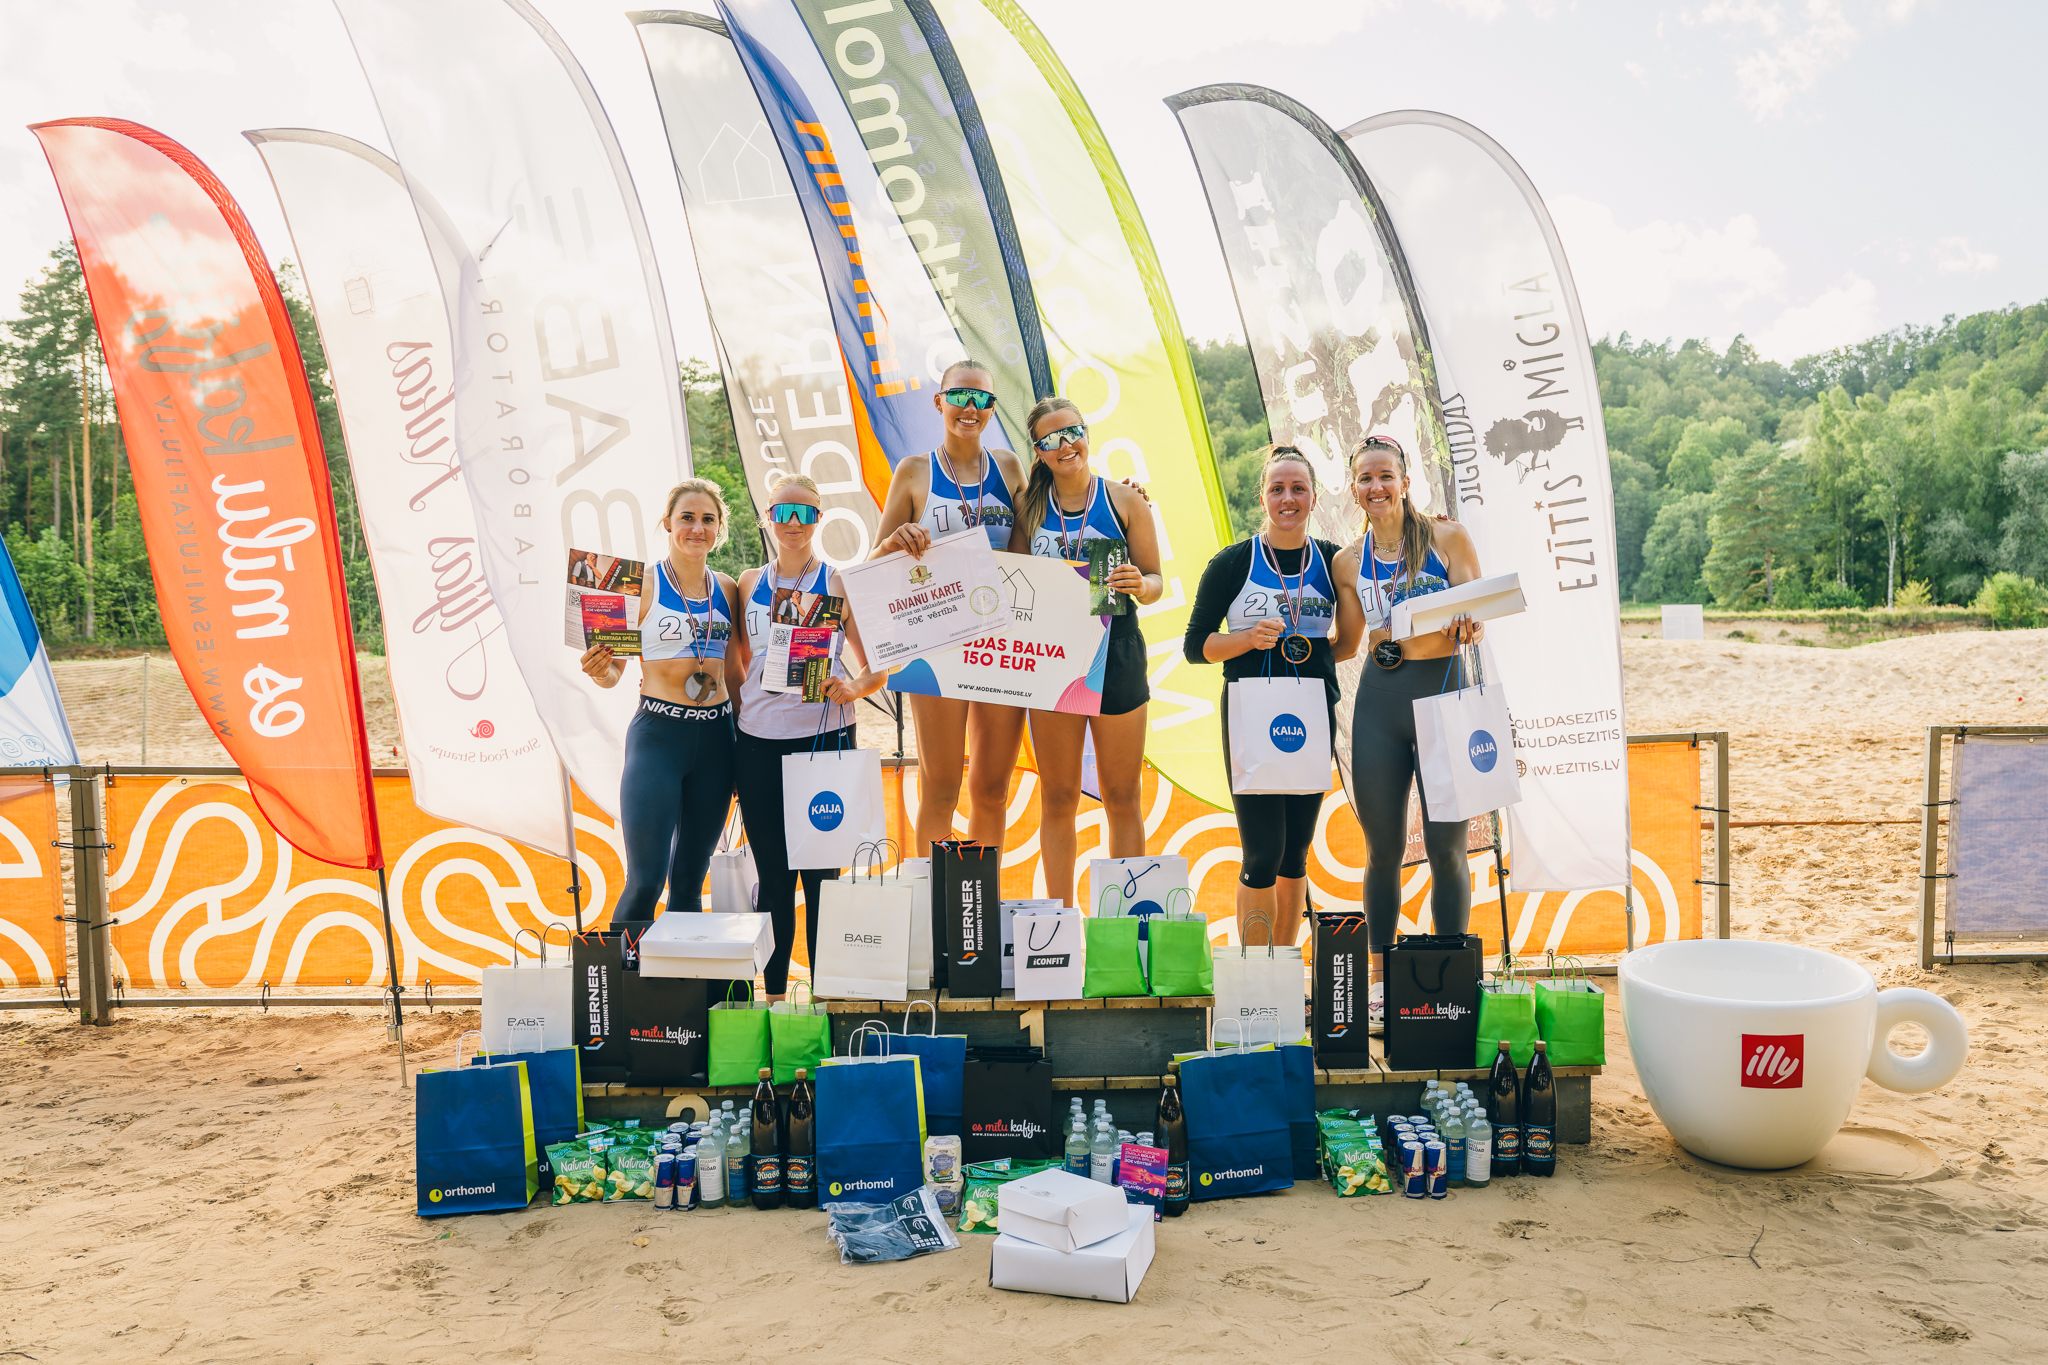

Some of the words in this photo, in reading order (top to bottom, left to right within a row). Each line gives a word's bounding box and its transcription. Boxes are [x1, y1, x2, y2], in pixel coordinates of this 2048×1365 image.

[933, 505, 950, 533] 1
[1034, 535, 1050, 558] 2
[888, 592, 929, 614] DĀVANU
[930, 581, 964, 601] KARTE
[1244, 592, 1268, 618] 2
[1362, 587, 1375, 612] 1
[747, 611, 759, 637] 1
[907, 615, 924, 626] 50€
[927, 605, 958, 620] vērtībā
[658, 615, 682, 641] 2
[1012, 640, 1066, 659] BALVA
[963, 650, 994, 666] 150
[1000, 655, 1036, 672] EUR
[957, 683, 1032, 697] WWW.MODERN-HOUSE.LV
[642, 699, 684, 718] NIKE
[684, 709, 718, 720] PRO
[1514, 709, 1617, 730] GULDASEZITIS
[1273, 726, 1304, 737] KAIJA
[1518, 729, 1620, 748] GULDASEZITIS
[1470, 742, 1496, 758] KAIJA
[811, 804, 842, 815] KAIJA
[975, 879, 983, 905] LIMITS
[962, 879, 975, 950] BERNER
[844, 933, 882, 944] BABE
[976, 921, 984, 951] PUSHING
[1033, 957, 1065, 966] iCONFIT
[601, 989, 609, 1004] THE
[1333, 953, 1345, 1024] BERNER
[588, 965, 600, 1036] BERNER
[1346, 992, 1354, 1023] PUSHING
[1412, 1003, 1435, 1015] mīlu
[507, 1017, 545, 1027] BABE
[601, 1004, 610, 1036] PUSHING
[630, 1028, 640, 1036] es
[642, 1025, 664, 1038] mīlu
[1746, 1044, 1800, 1085] illy
[972, 1123, 983, 1131] es
[985, 1119, 1009, 1132] mīlu
[560, 1157, 595, 1173] Naturals
[618, 1156, 651, 1170] Naturals
[1344, 1151, 1377, 1165] Naturals
[1214, 1164, 1263, 1180] orthomol
[445, 1183, 496, 1198] orthomol
[844, 1177, 894, 1191] orthomol
